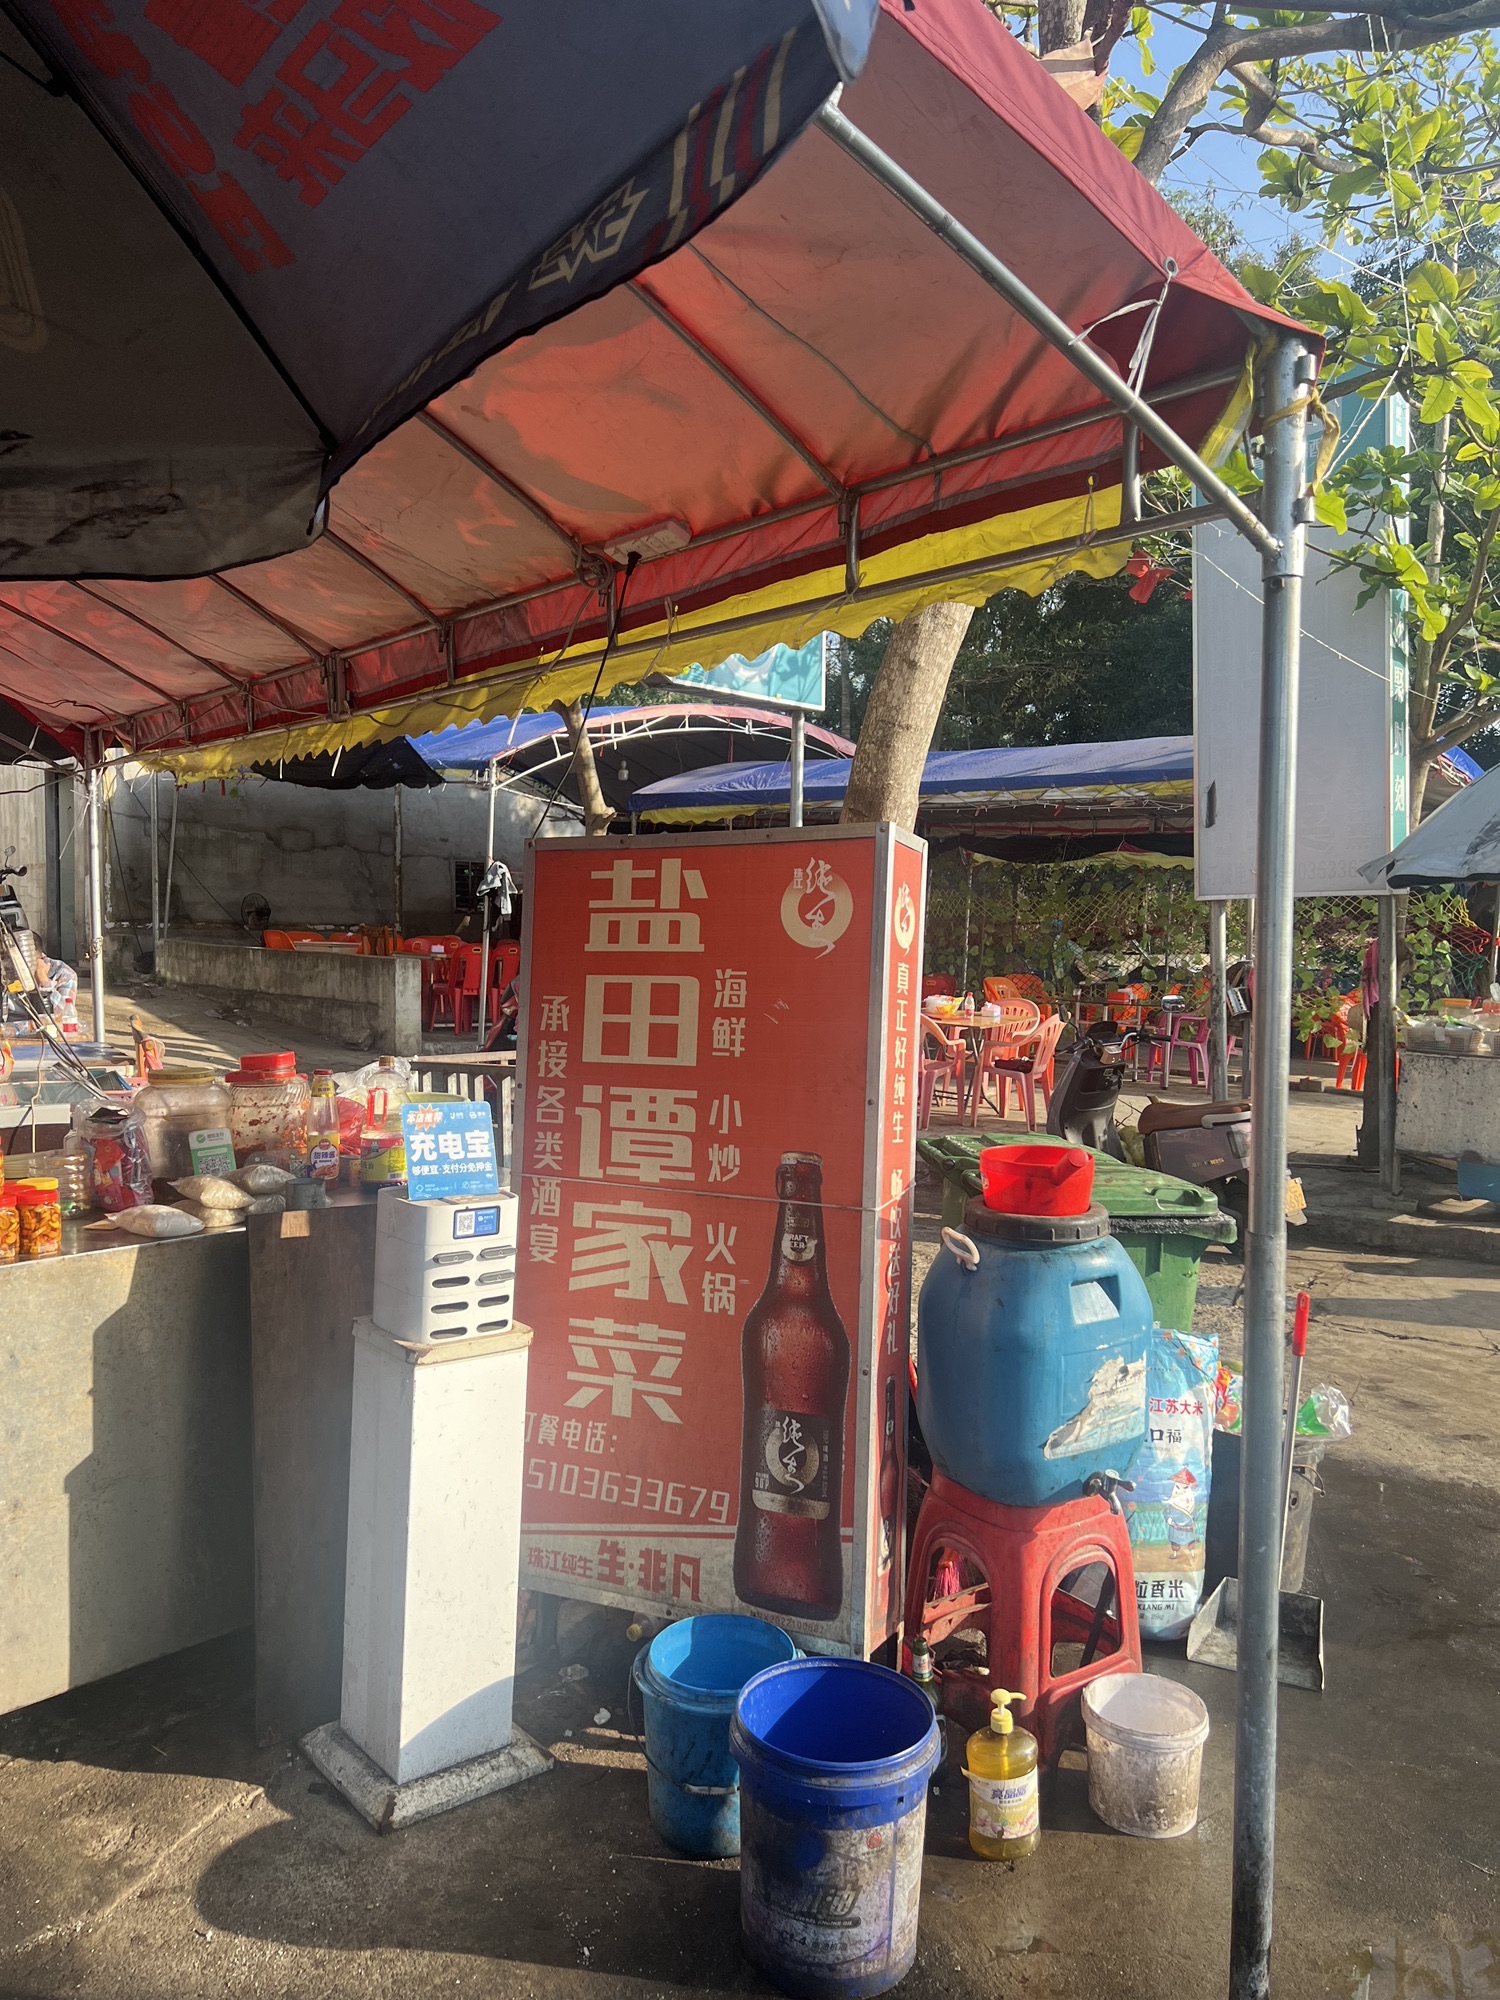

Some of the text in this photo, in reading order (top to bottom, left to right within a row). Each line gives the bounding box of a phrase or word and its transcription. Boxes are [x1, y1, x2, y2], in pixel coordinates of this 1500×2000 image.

[891, 961, 911, 1145] 真正好纯生
[409, 1130, 492, 1162] 充电宝
[529, 995, 570, 1265] 承接各类酒宴
[563, 857, 709, 1424] 盐田谭家菜
[702, 968, 748, 1316] 海鲜 小炒 火锅
[1144, 1428, 1183, 1444] 口福
[1149, 1397, 1204, 1416] 江苏大米
[526, 1458, 731, 1524] 5103633679
[527, 1546, 594, 1579] 珠江纯生
